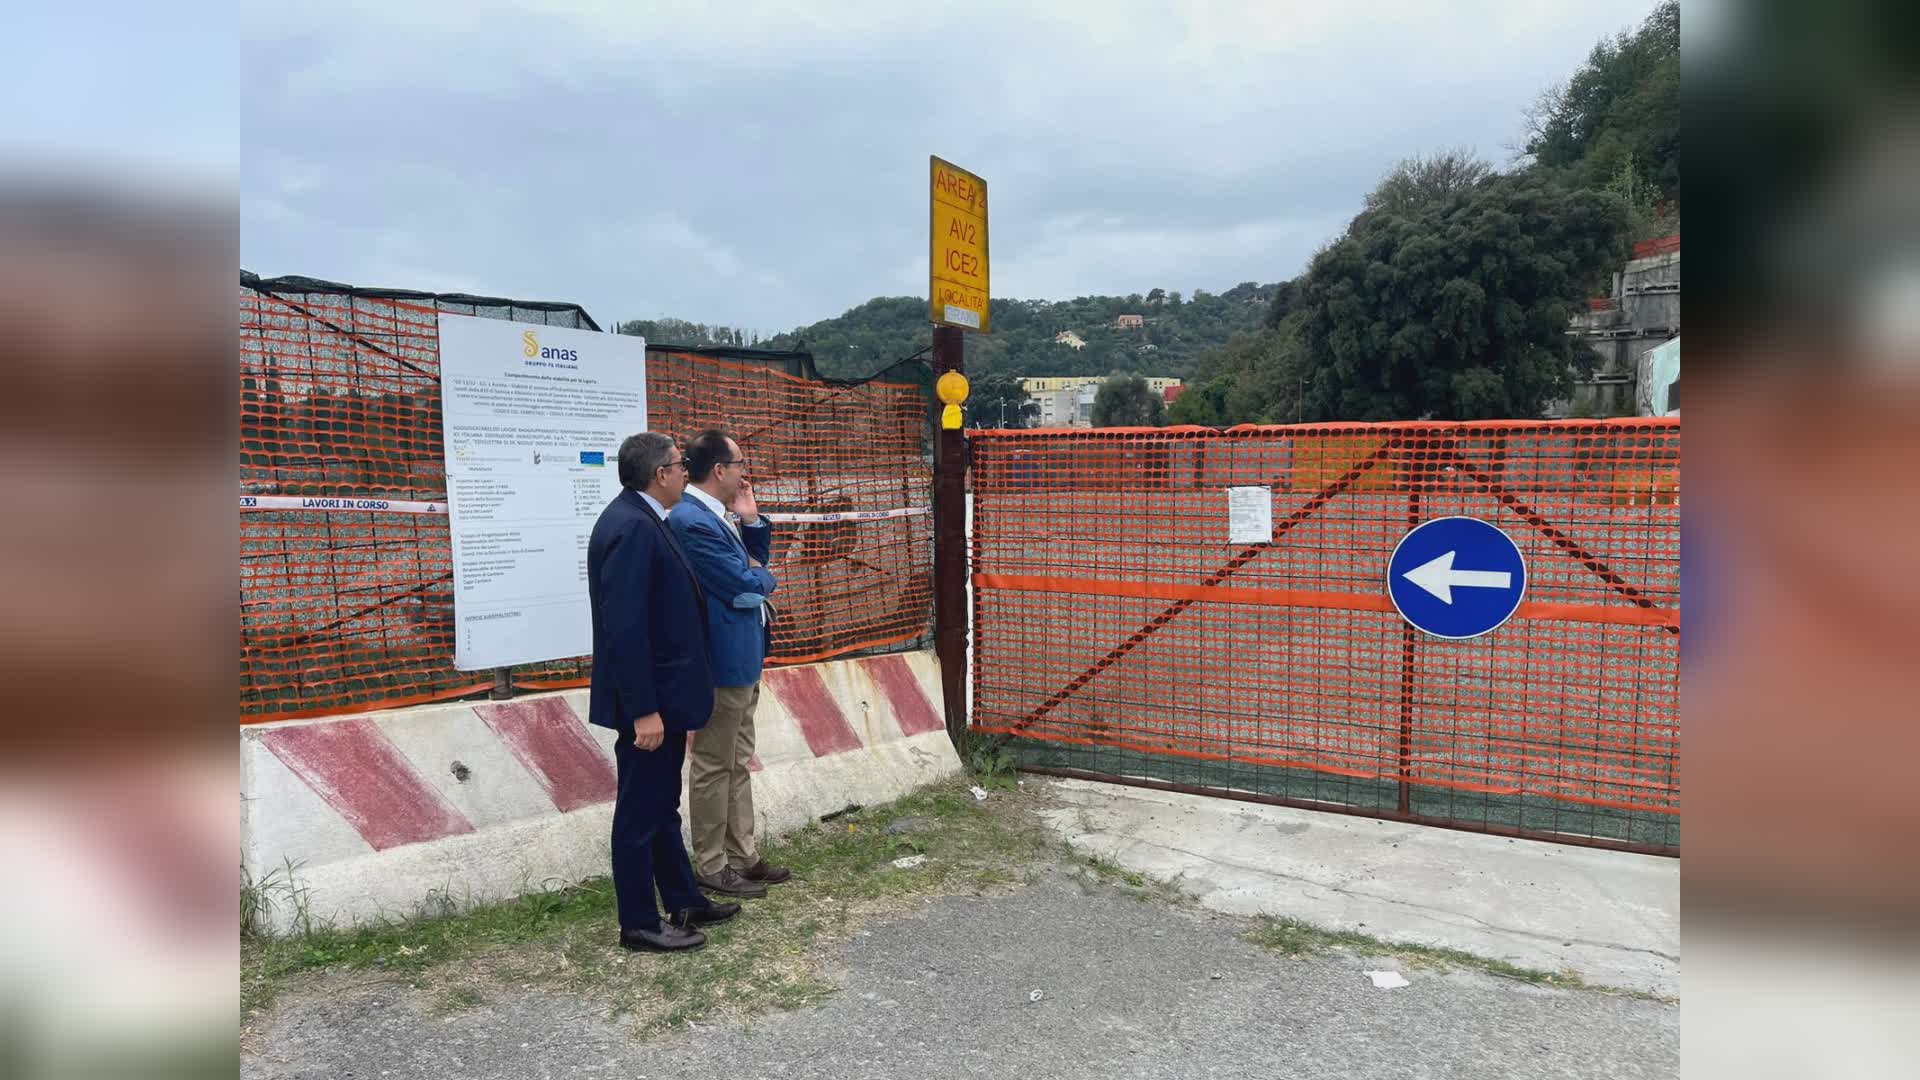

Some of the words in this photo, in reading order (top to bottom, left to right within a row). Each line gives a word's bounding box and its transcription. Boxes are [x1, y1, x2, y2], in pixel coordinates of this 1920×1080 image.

[936, 169, 976, 202] AREA
[949, 217, 976, 245] AV2
[945, 248, 978, 277] ICE2
[541, 346, 578, 361] anas
[302, 498, 340, 508] LAVORI
[342, 499, 354, 508] IN
[356, 500, 389, 509] CORSO
